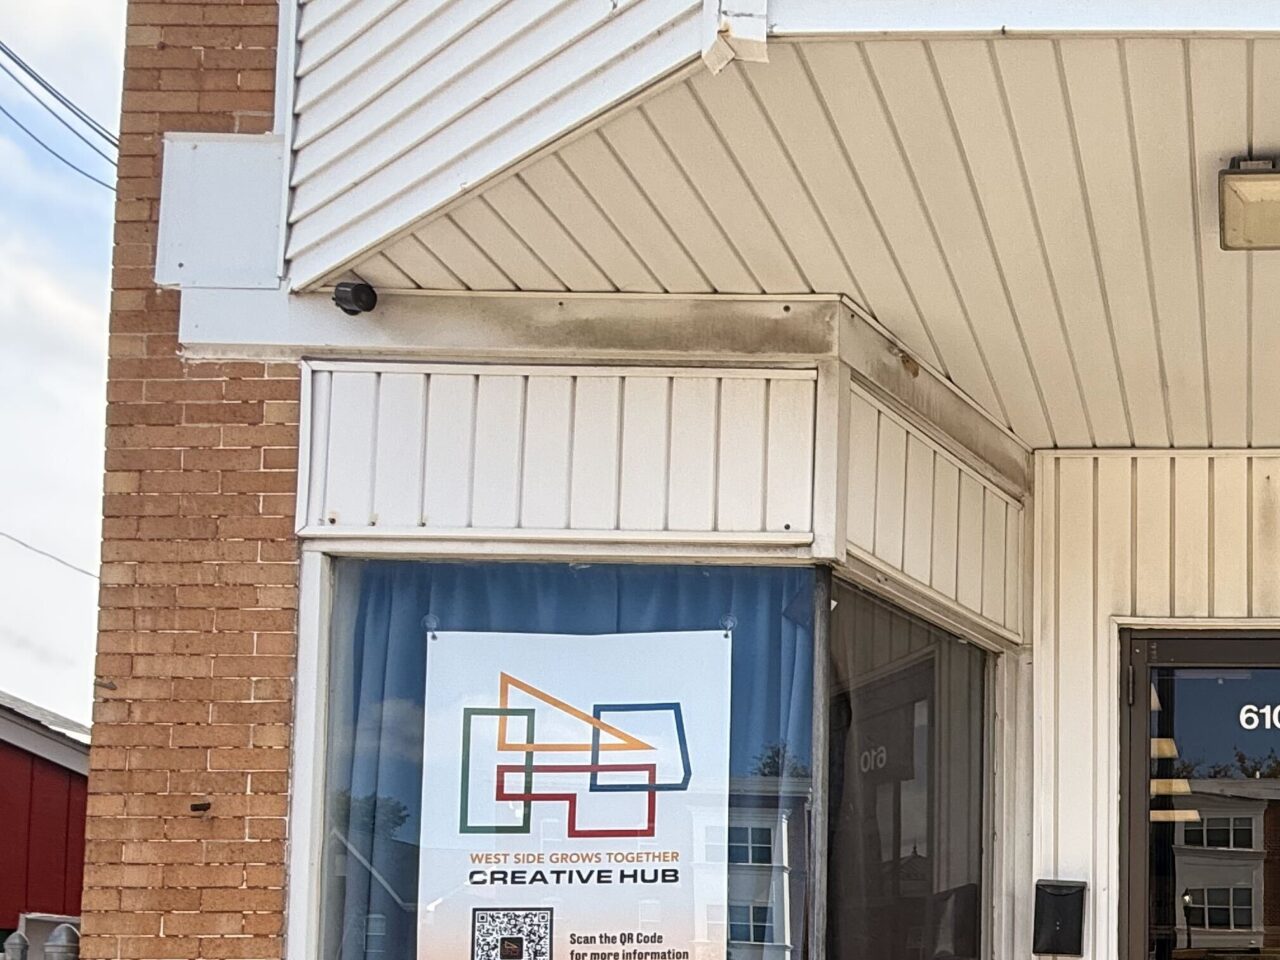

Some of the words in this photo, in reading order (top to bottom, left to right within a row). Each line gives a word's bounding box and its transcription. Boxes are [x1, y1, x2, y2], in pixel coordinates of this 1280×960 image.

[470, 853, 510, 864] WEST
[514, 853, 545, 864] SIDE
[549, 852, 601, 864] GROWS
[606, 852, 679, 863] TOGETHER
[469, 870, 613, 885] CREATIVE
[619, 869, 680, 884] HUB
[569, 933, 596, 944] Scan
[599, 933, 617, 944] the
[619, 933, 634, 945] QR
[636, 932, 663, 944] Code
[590, 951, 620, 960] more
[622, 949, 689, 960] information
